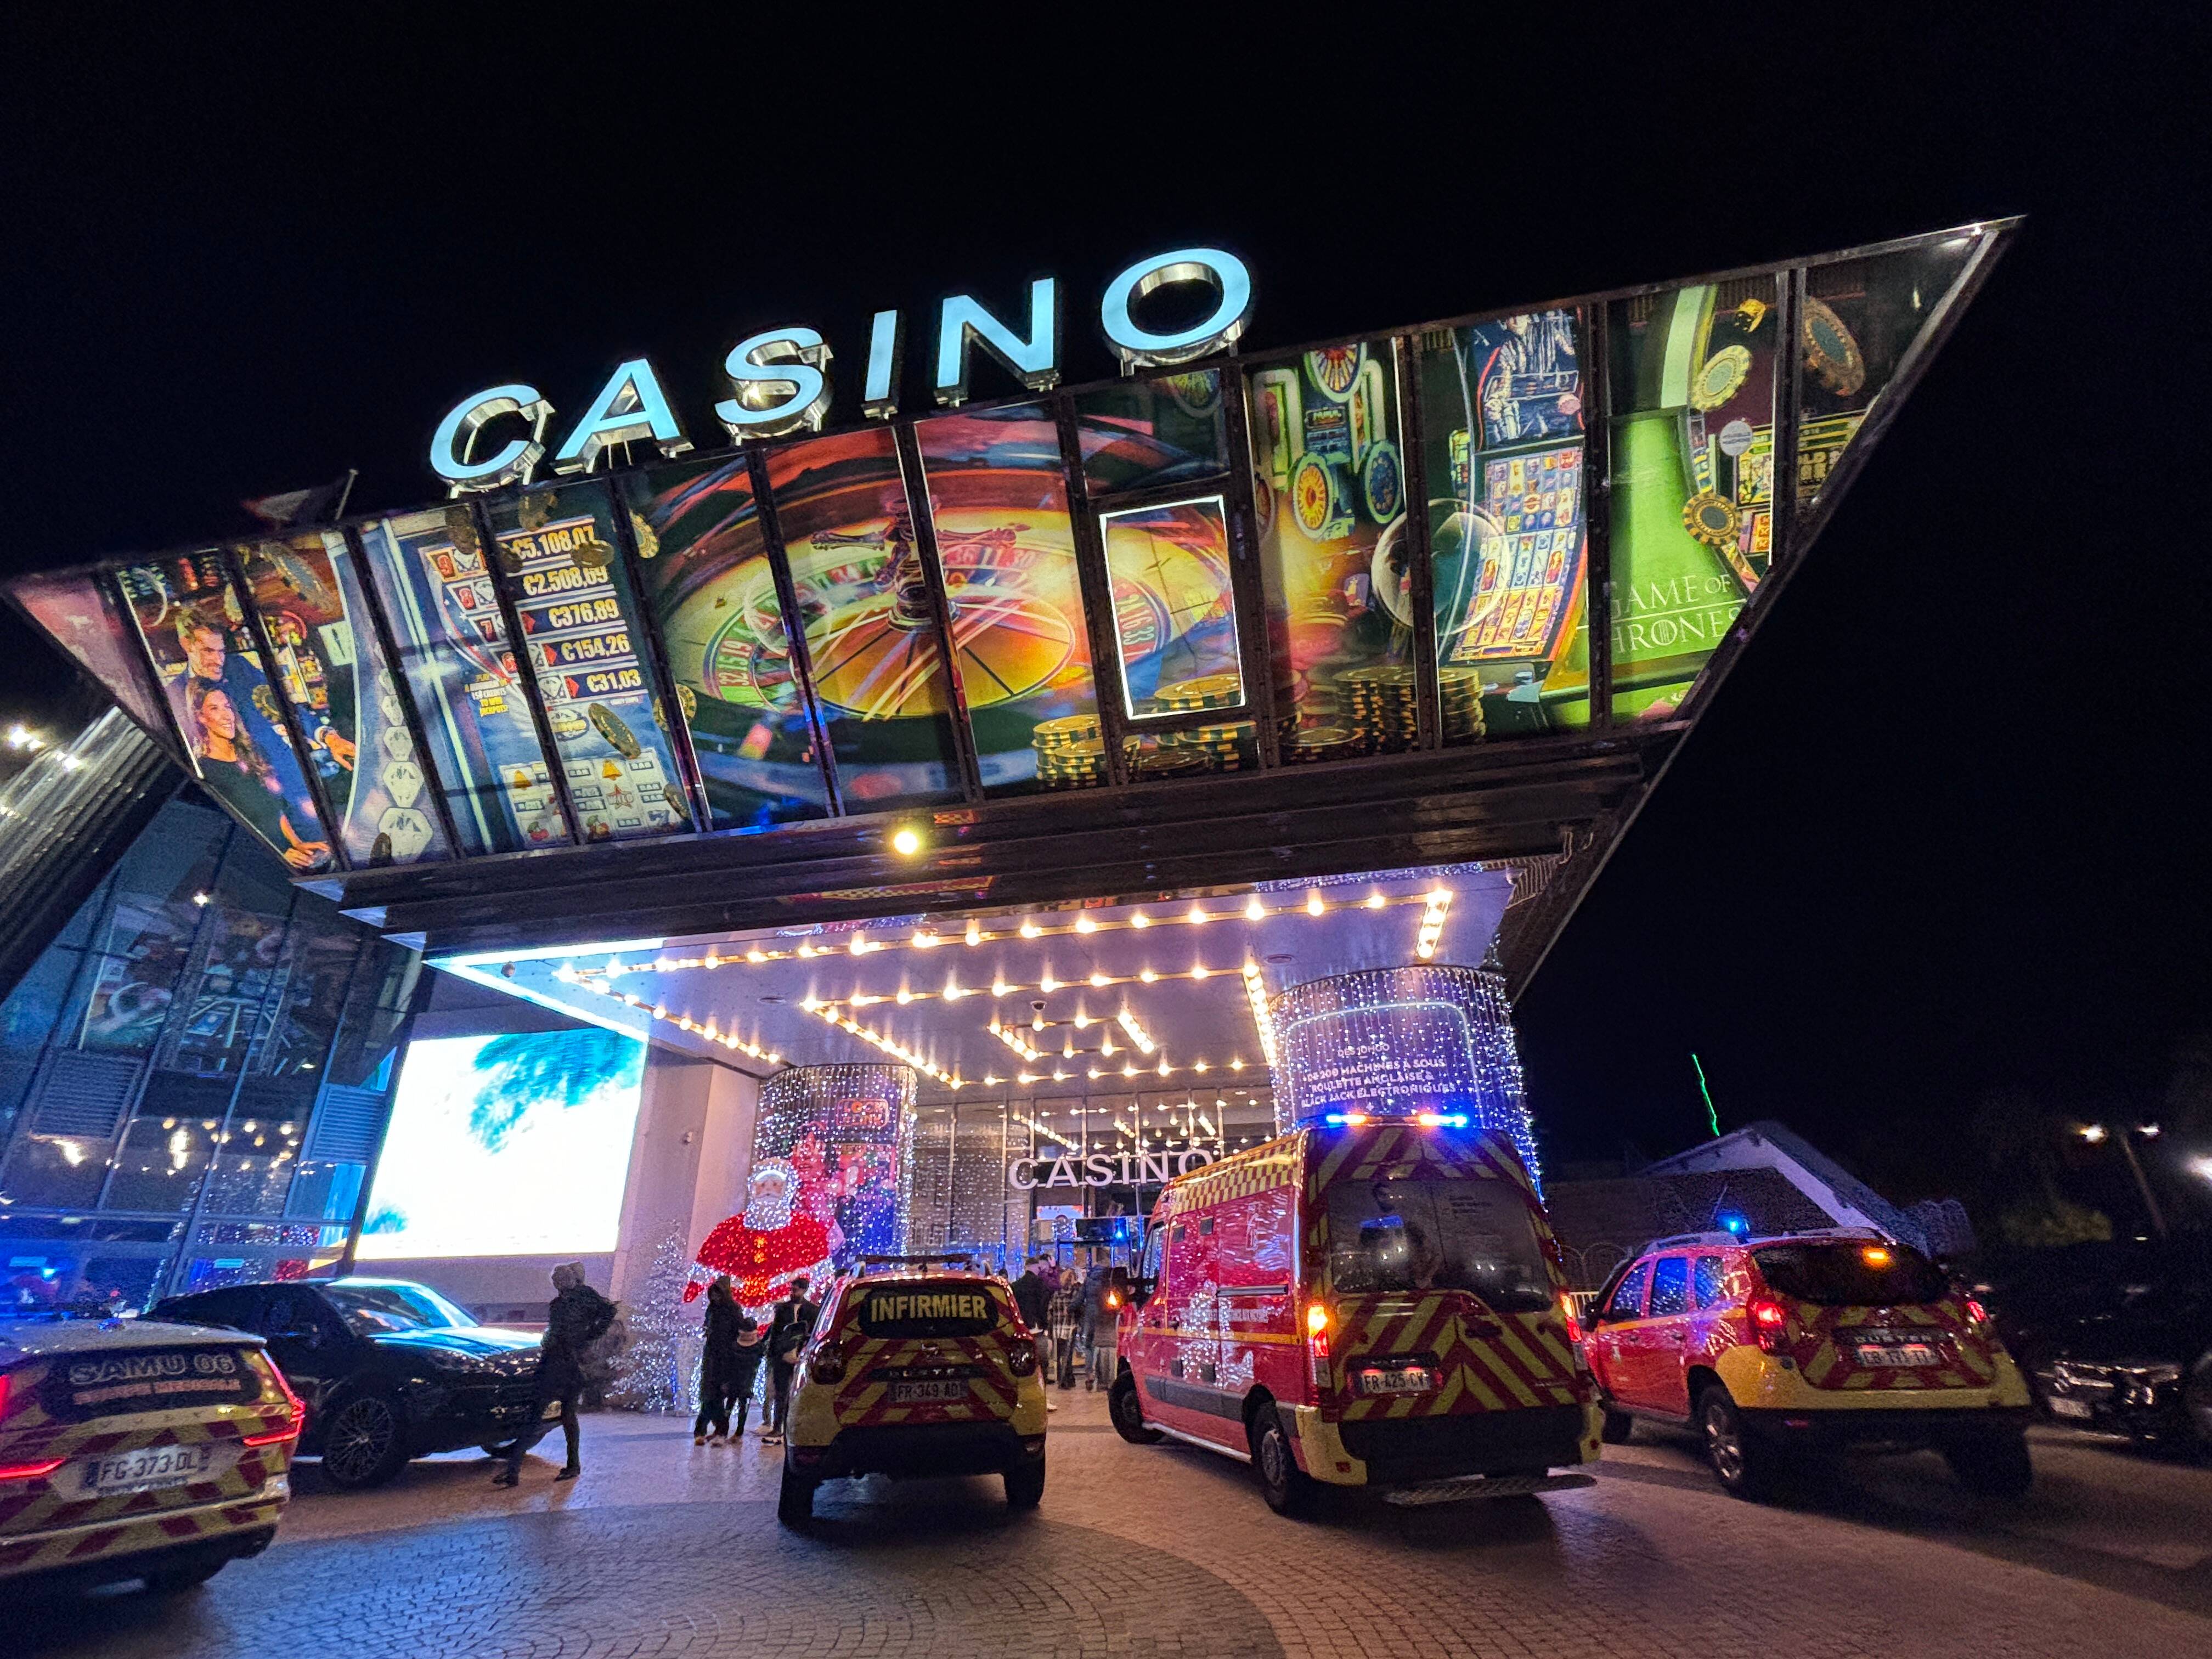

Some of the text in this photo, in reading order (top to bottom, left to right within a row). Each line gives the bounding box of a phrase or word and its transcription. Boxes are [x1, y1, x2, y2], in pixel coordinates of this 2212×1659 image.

[430, 247, 1253, 484] CASINO
[1705, 574, 1731, 594] OF
[549, 598, 619, 628] €376,89
[561, 634, 630, 662] €154,26
[586, 669, 641, 692] €31,03
[1311, 1076, 1362, 1093] ROULETTE
[1363, 1071, 1423, 1086] ANGLAISE
[1319, 1068, 1339, 1080] 200
[1341, 1060, 1401, 1076] MACHINES
[1413, 1058, 1446, 1068] SOUS
[1009, 1149, 1214, 1190] CASINO
[871, 1294, 988, 1322] INFIRMIER
[70, 1355, 188, 1385] SAMU
